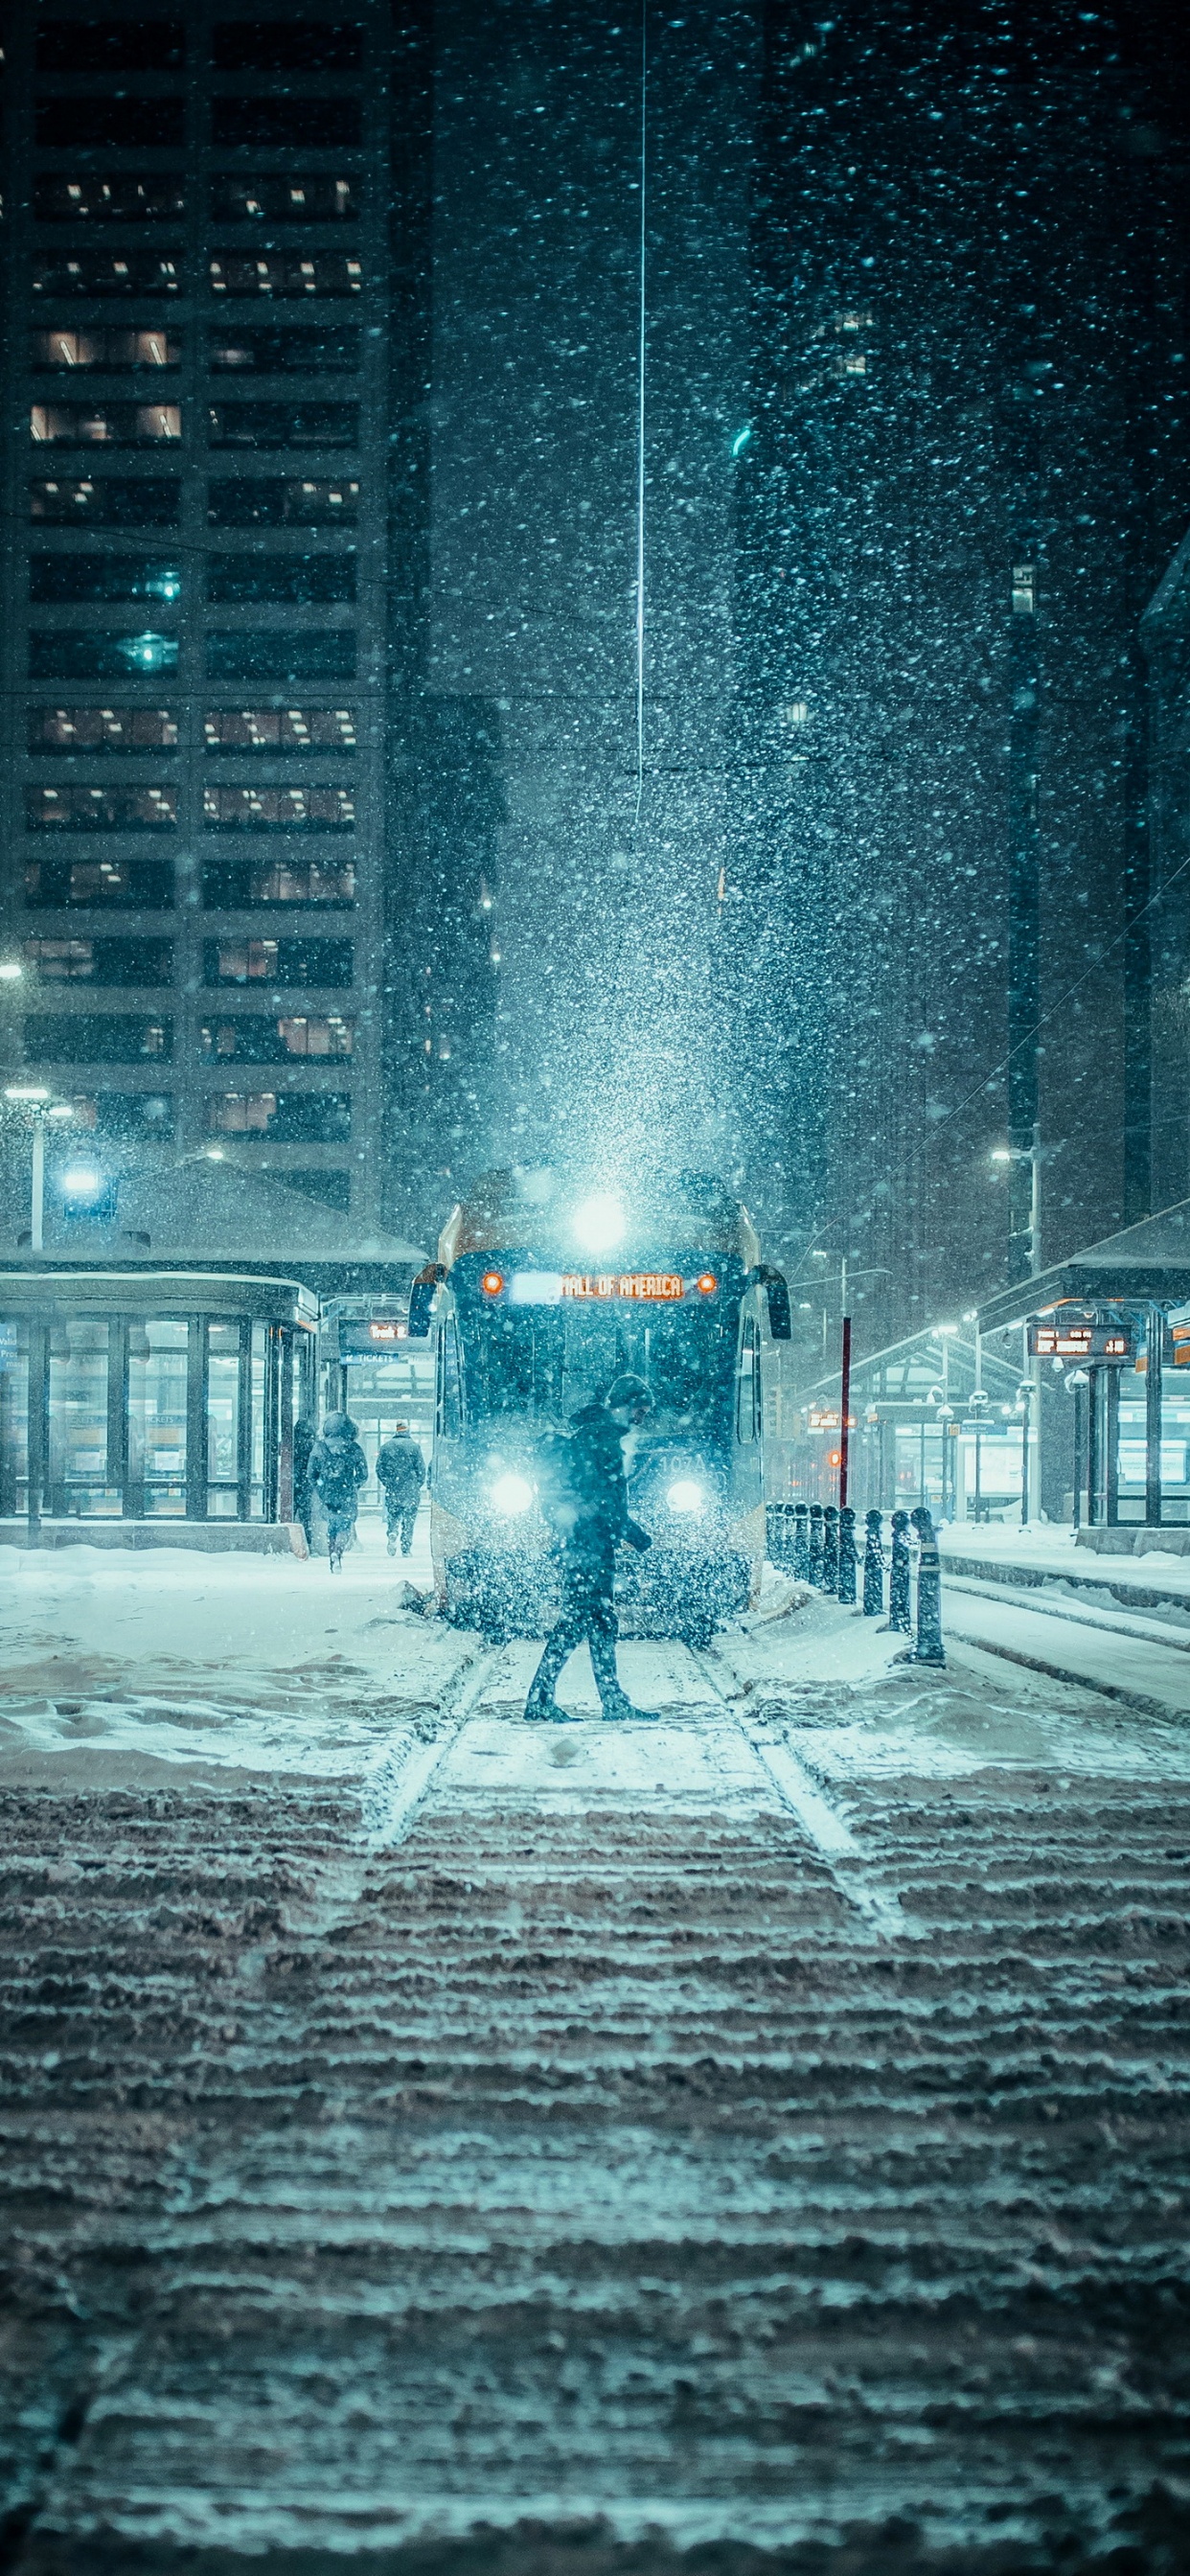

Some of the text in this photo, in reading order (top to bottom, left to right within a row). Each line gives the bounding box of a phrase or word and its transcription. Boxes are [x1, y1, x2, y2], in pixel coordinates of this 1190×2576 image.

[561, 1275, 681, 1297] MALL OF AMERICA
[358, 1354, 394, 1363] TICKETS
